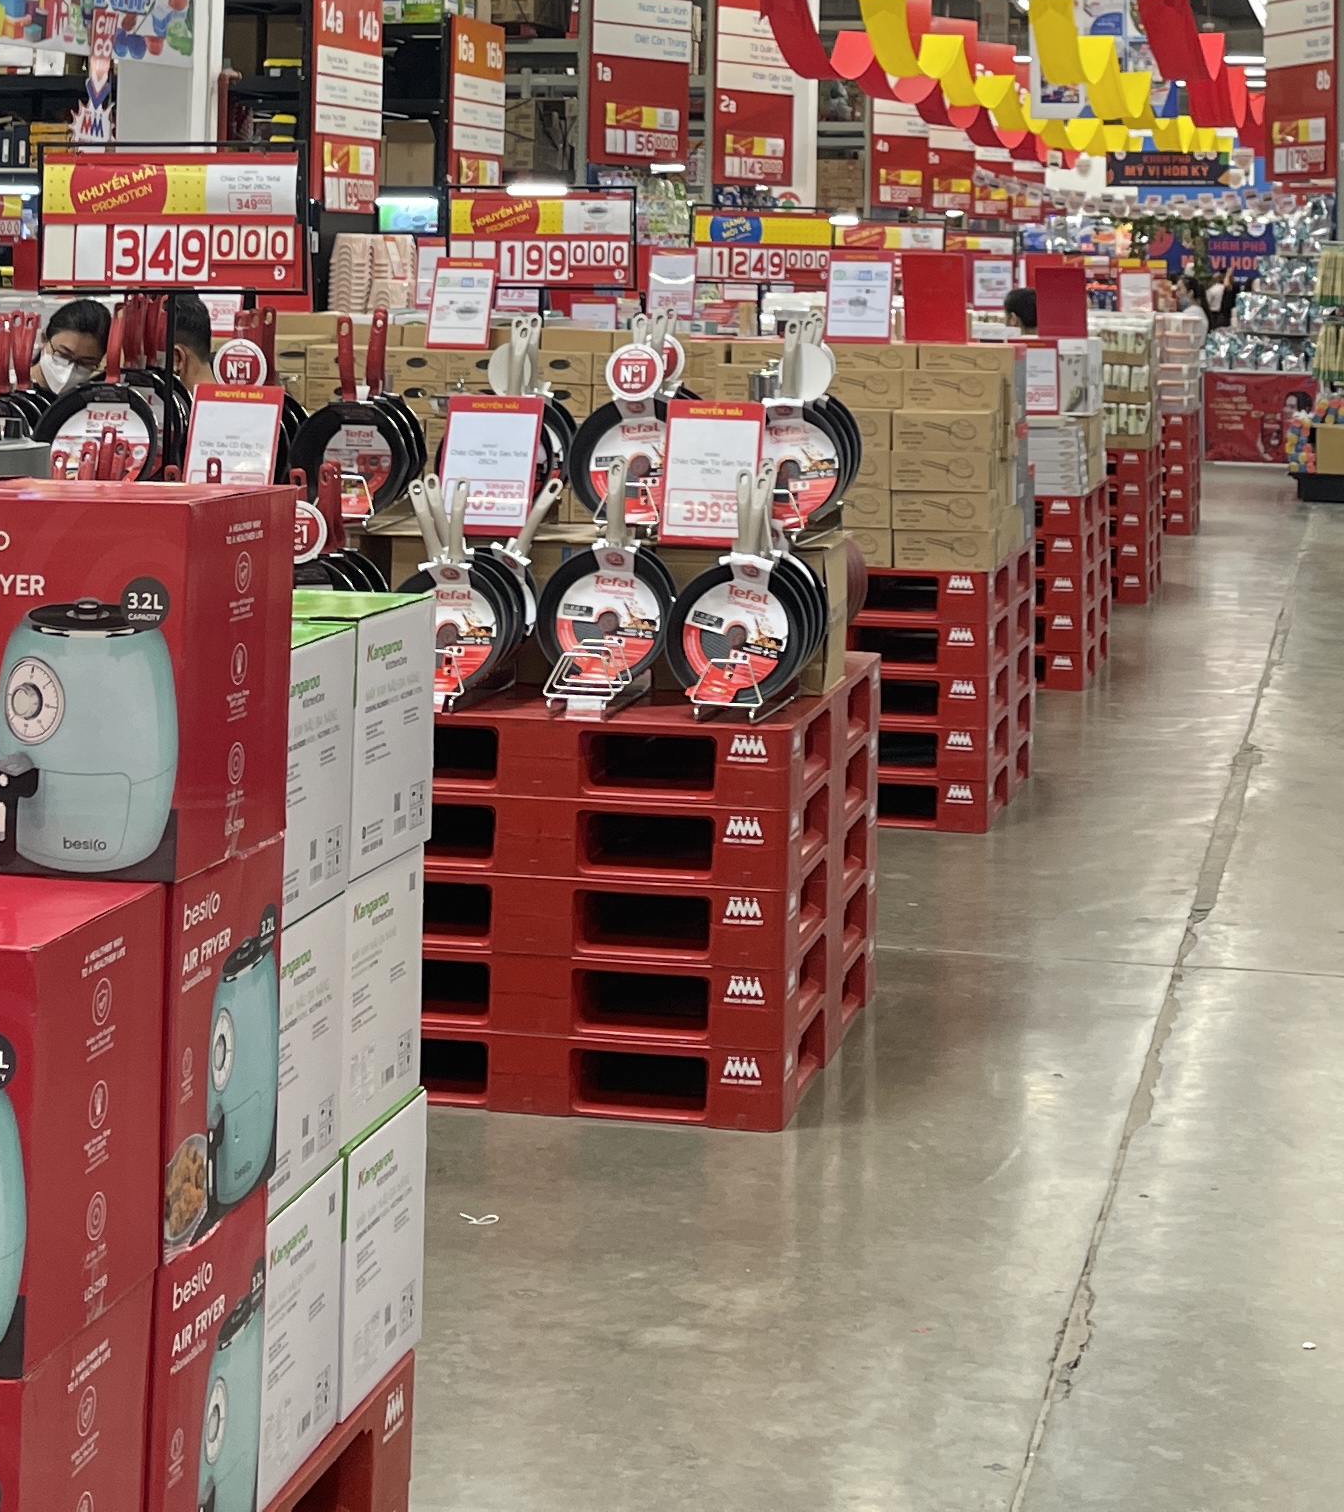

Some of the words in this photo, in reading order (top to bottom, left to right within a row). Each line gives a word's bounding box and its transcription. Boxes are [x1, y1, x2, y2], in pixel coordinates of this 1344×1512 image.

[321, 0, 344, 34] 14a
[359, 9, 380, 43] 14b
[457, 34, 475, 64] 16a
[486, 41, 503, 70] 16b
[596, 61, 612, 82] 1a
[718, 94, 737, 113] 2a
[91, 183, 154, 215] PROMOTION
[86, 409, 130, 421] Tefal
[344, 428, 374, 439] Tefal
[619, 423, 659, 436] Tefal
[766, 425, 810, 438] Tefal
[594, 575, 635, 590] Tefal
[127, 589, 164, 611] 3.2L
[727, 584, 770, 604] Tefal
[366, 639, 403, 663] Kangaroo
[268, 1223, 308, 1271] Kangaroo
